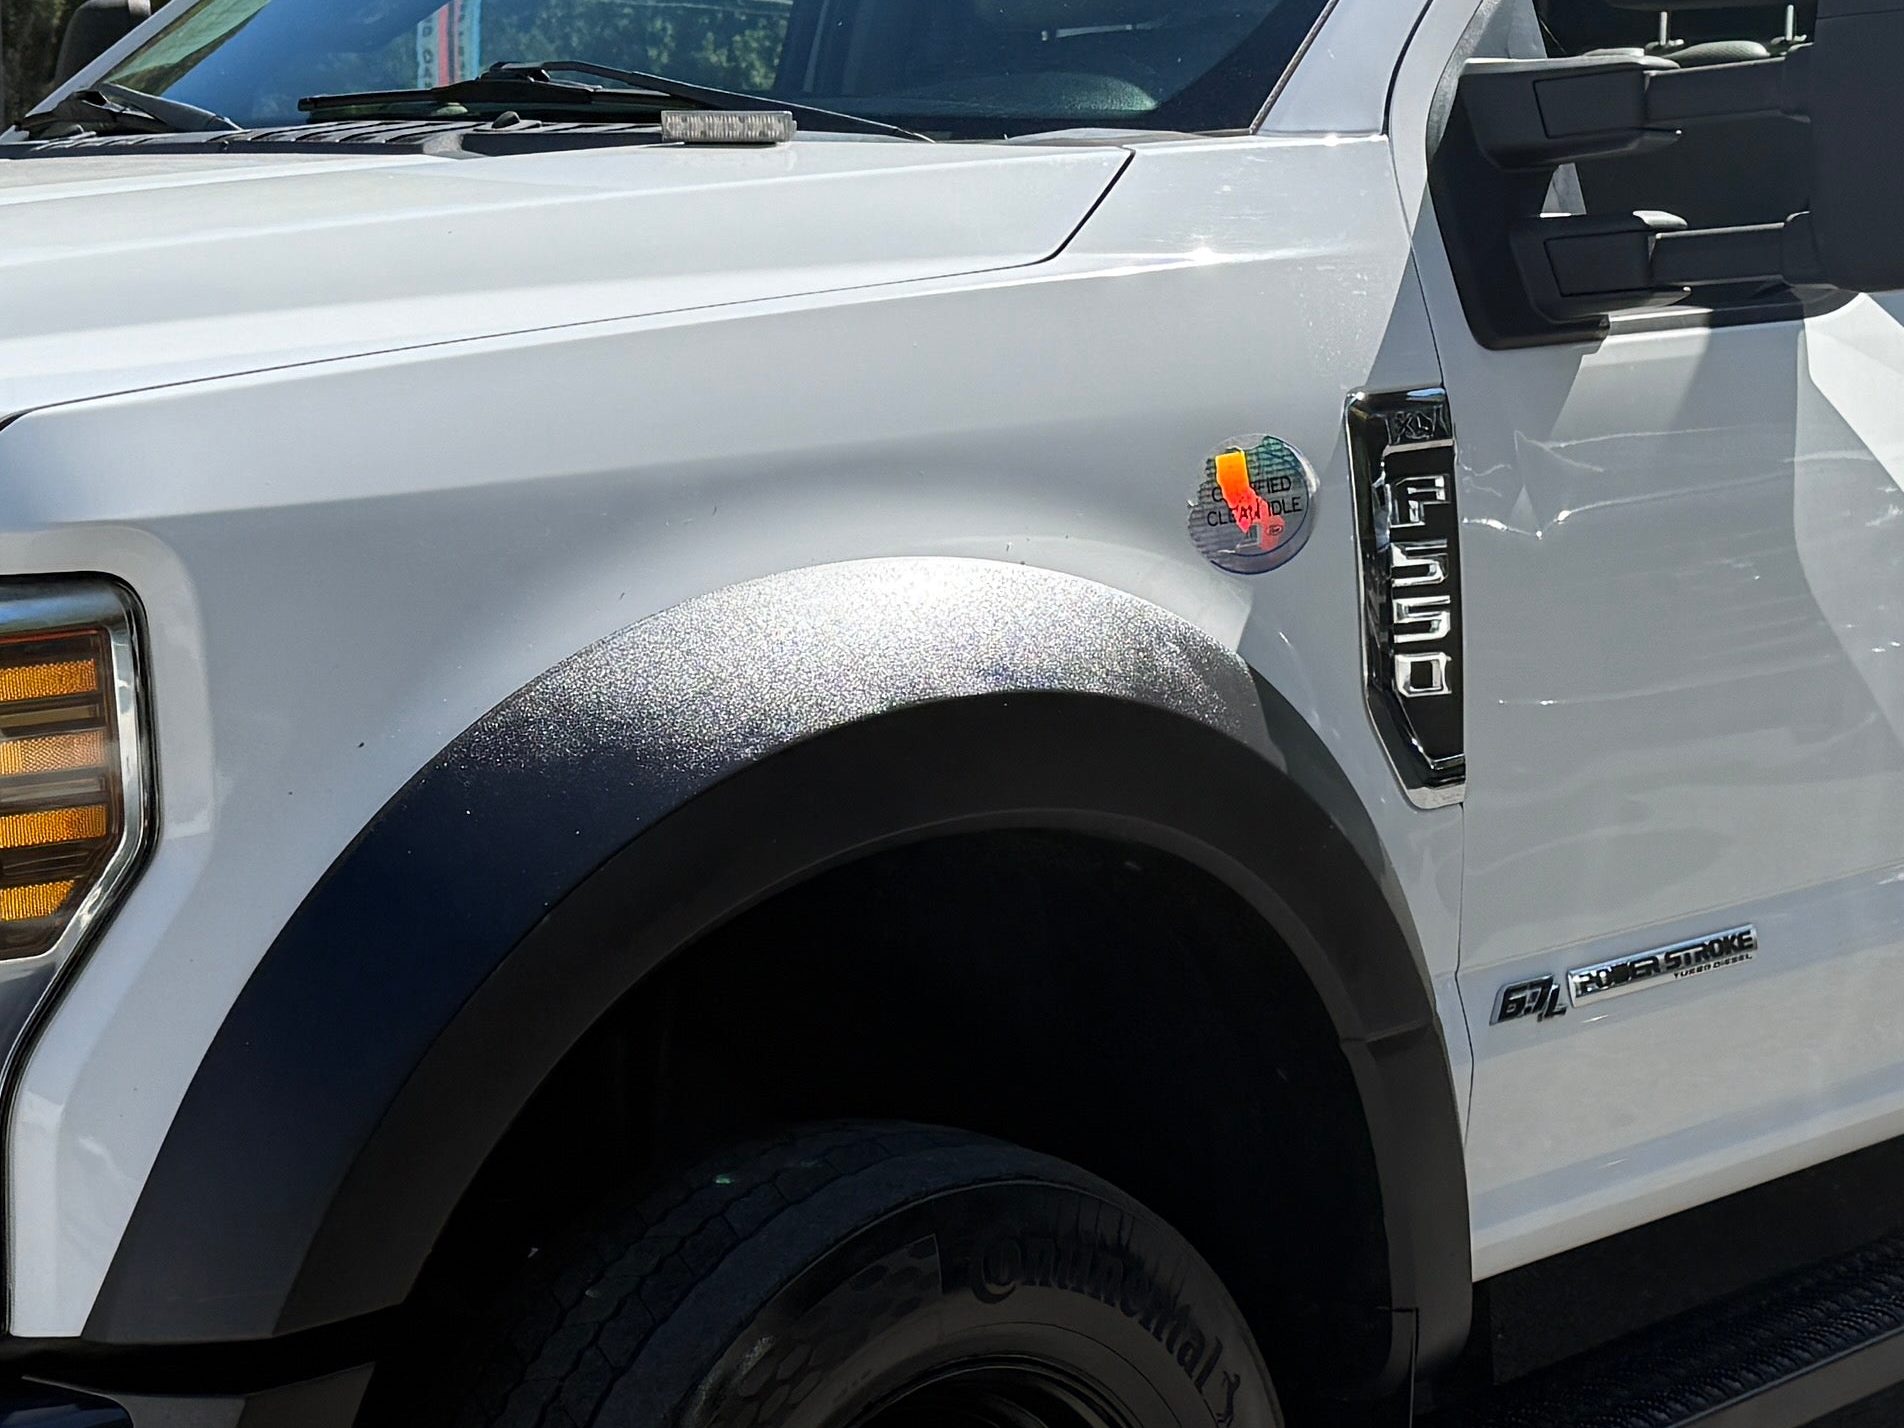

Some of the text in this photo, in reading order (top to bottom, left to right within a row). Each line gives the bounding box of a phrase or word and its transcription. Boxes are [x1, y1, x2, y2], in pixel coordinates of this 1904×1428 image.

[1207, 497, 1303, 527] CLEAN IDLE
[1664, 929, 1755, 970] STROKE
